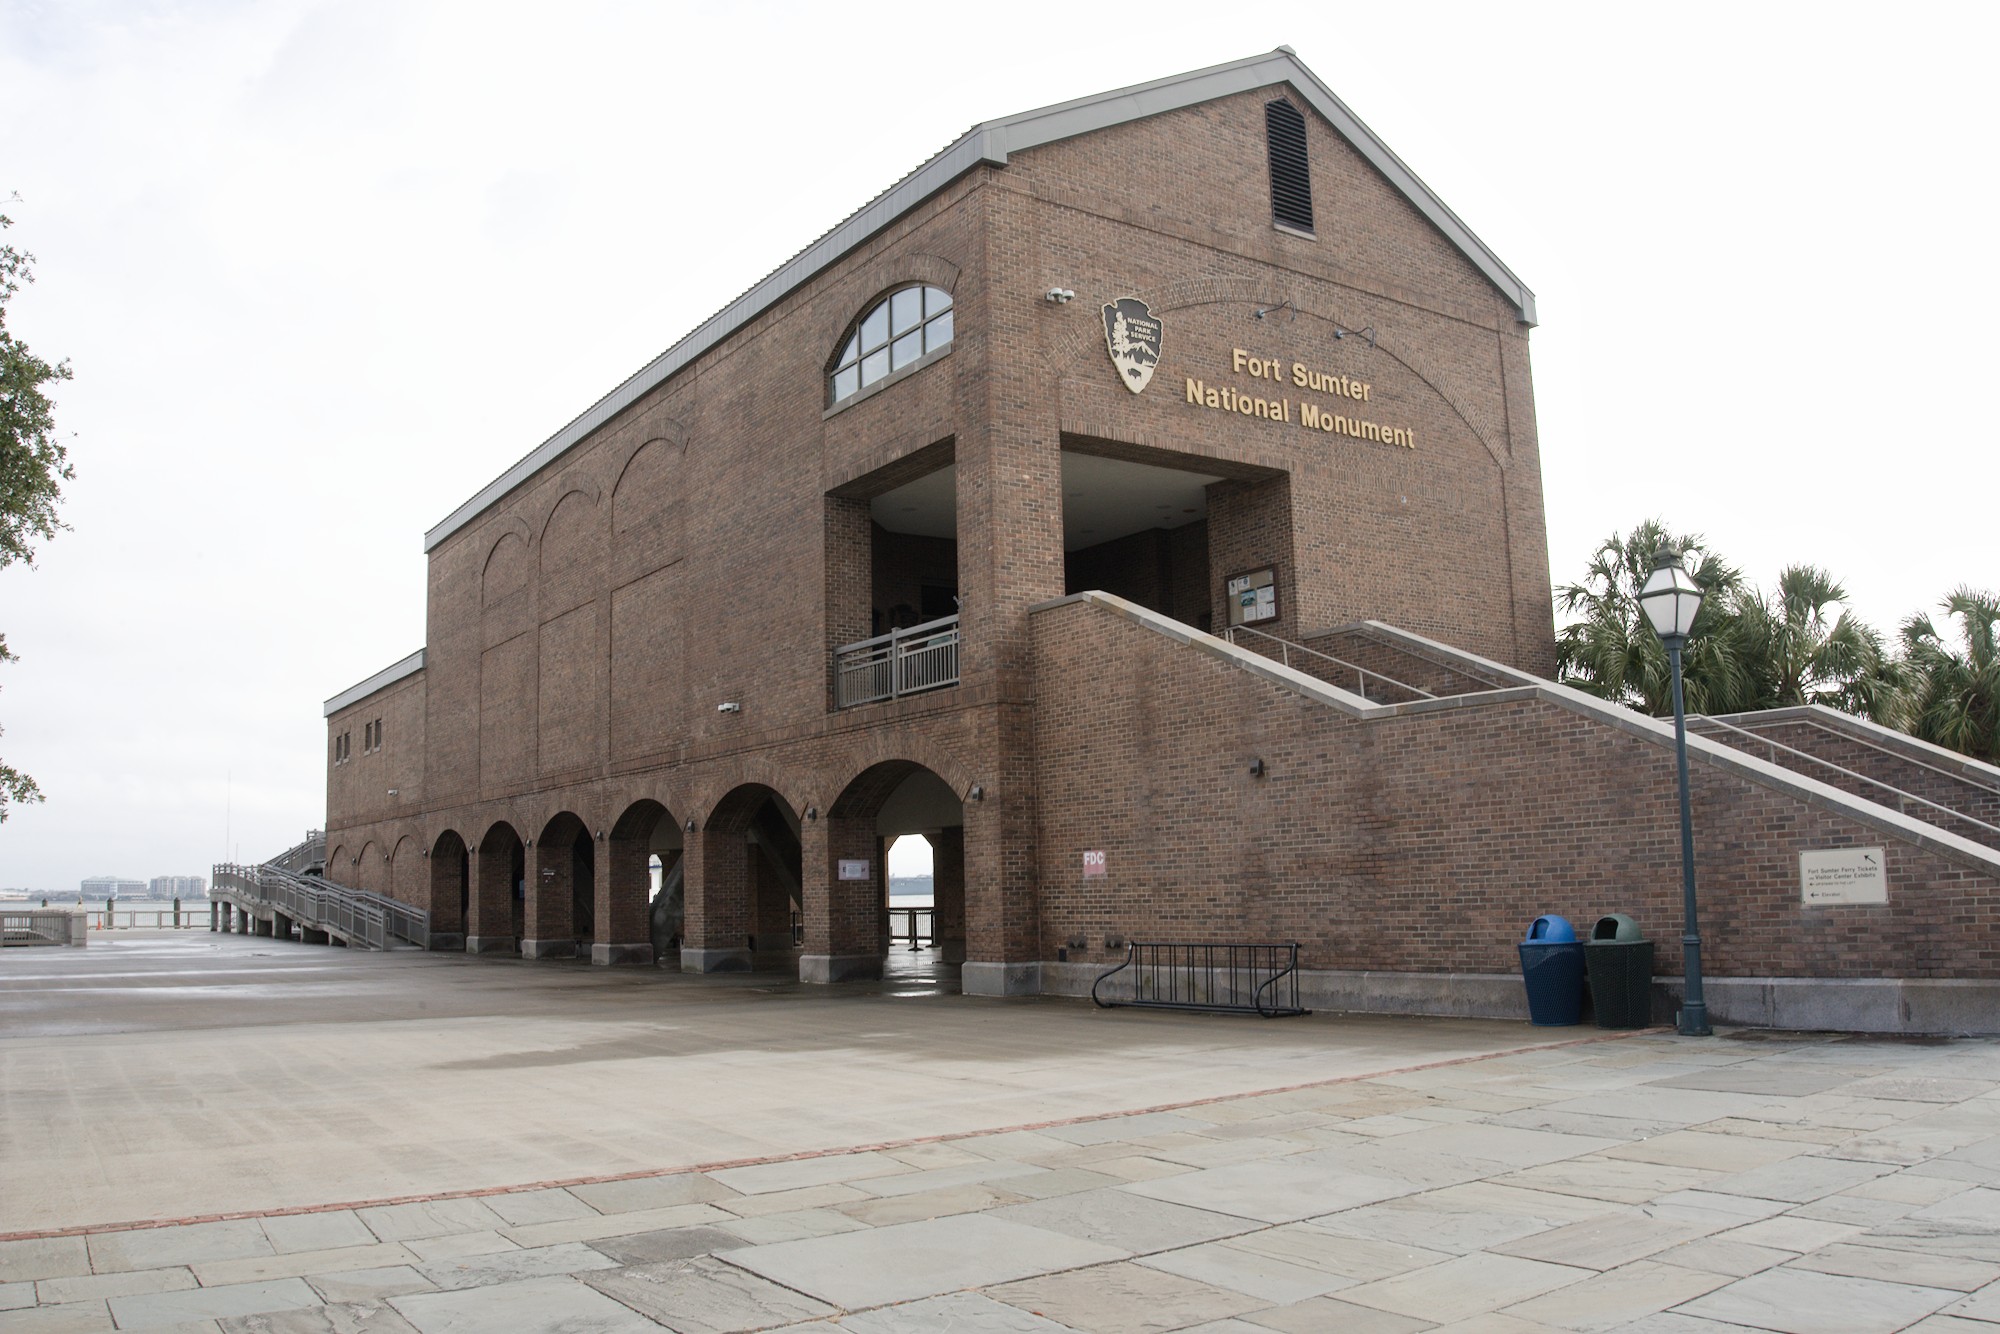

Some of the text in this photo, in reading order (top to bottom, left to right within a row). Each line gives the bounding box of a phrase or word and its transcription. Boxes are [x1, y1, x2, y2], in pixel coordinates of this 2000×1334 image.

[1127, 317, 1158, 330] NATIONAL
[1134, 325, 1151, 335] PARK
[1131, 331, 1156, 343] SERVICE
[1232, 348, 1371, 402] Fort Sumter
[1186, 377, 1415, 449] National Monument
[1084, 852, 1104, 865] FDC
